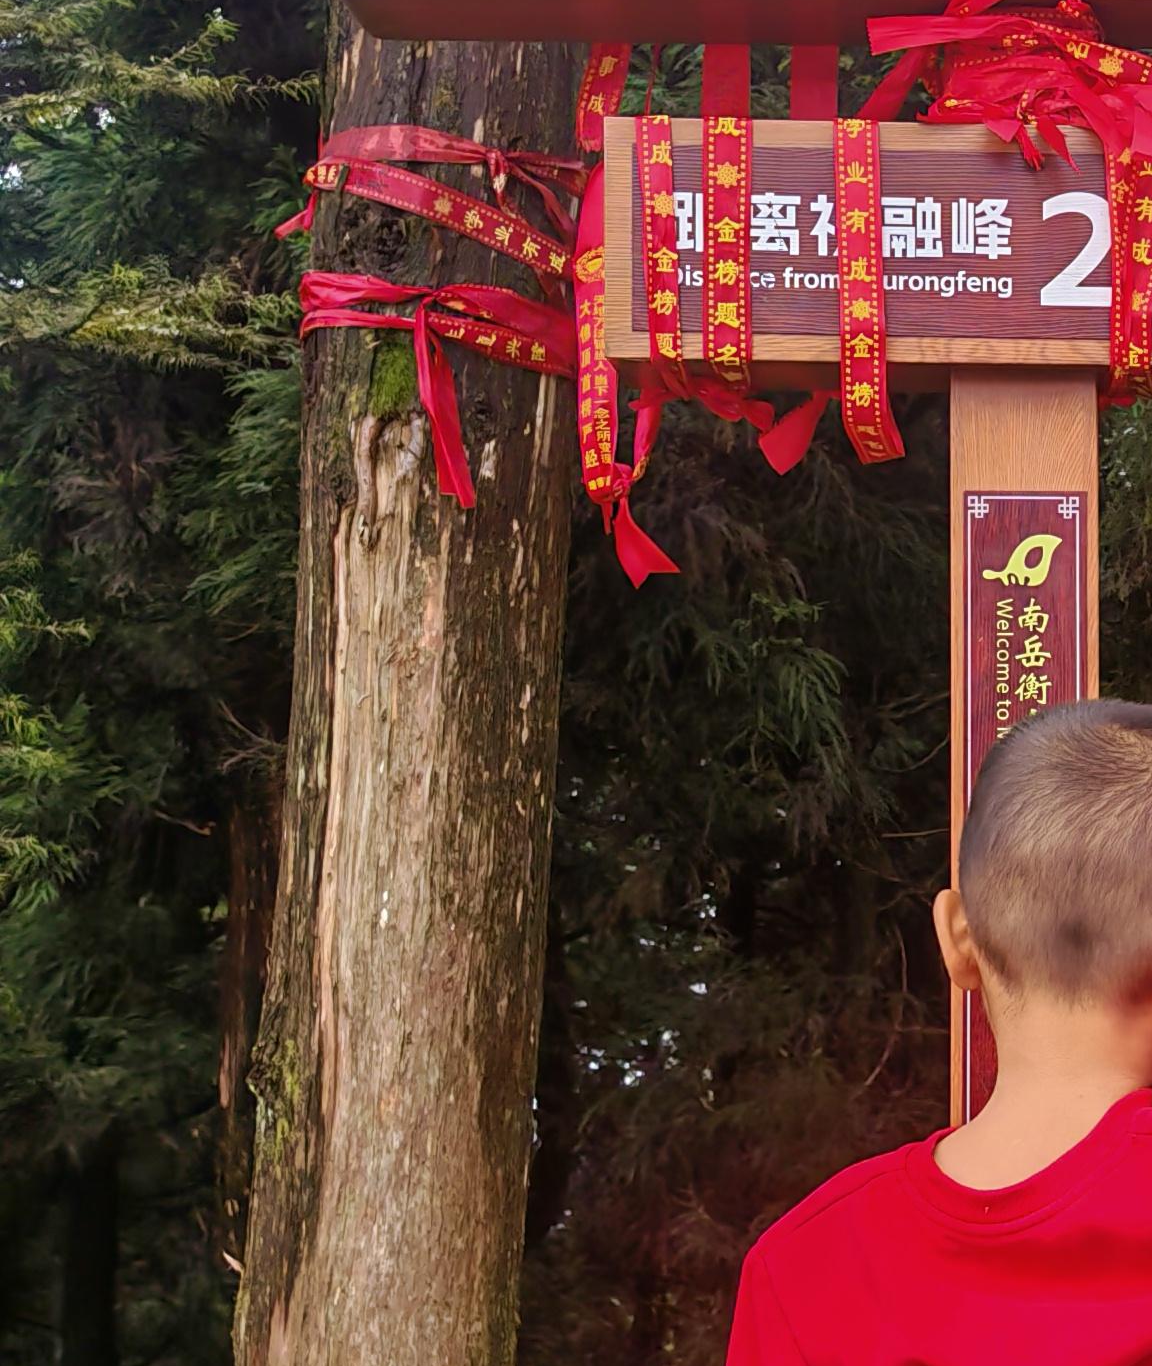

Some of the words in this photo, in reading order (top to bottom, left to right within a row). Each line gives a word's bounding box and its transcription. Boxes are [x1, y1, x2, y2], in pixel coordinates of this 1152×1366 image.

[714, 216, 741, 367] 金榜题名
[783, 267, 840, 290] from
[883, 270, 1013, 298] urongfeng
[996, 598, 1014, 695] Welcome
[1014, 597, 1053, 716] 南岳衡
[996, 699, 1012, 721] to
